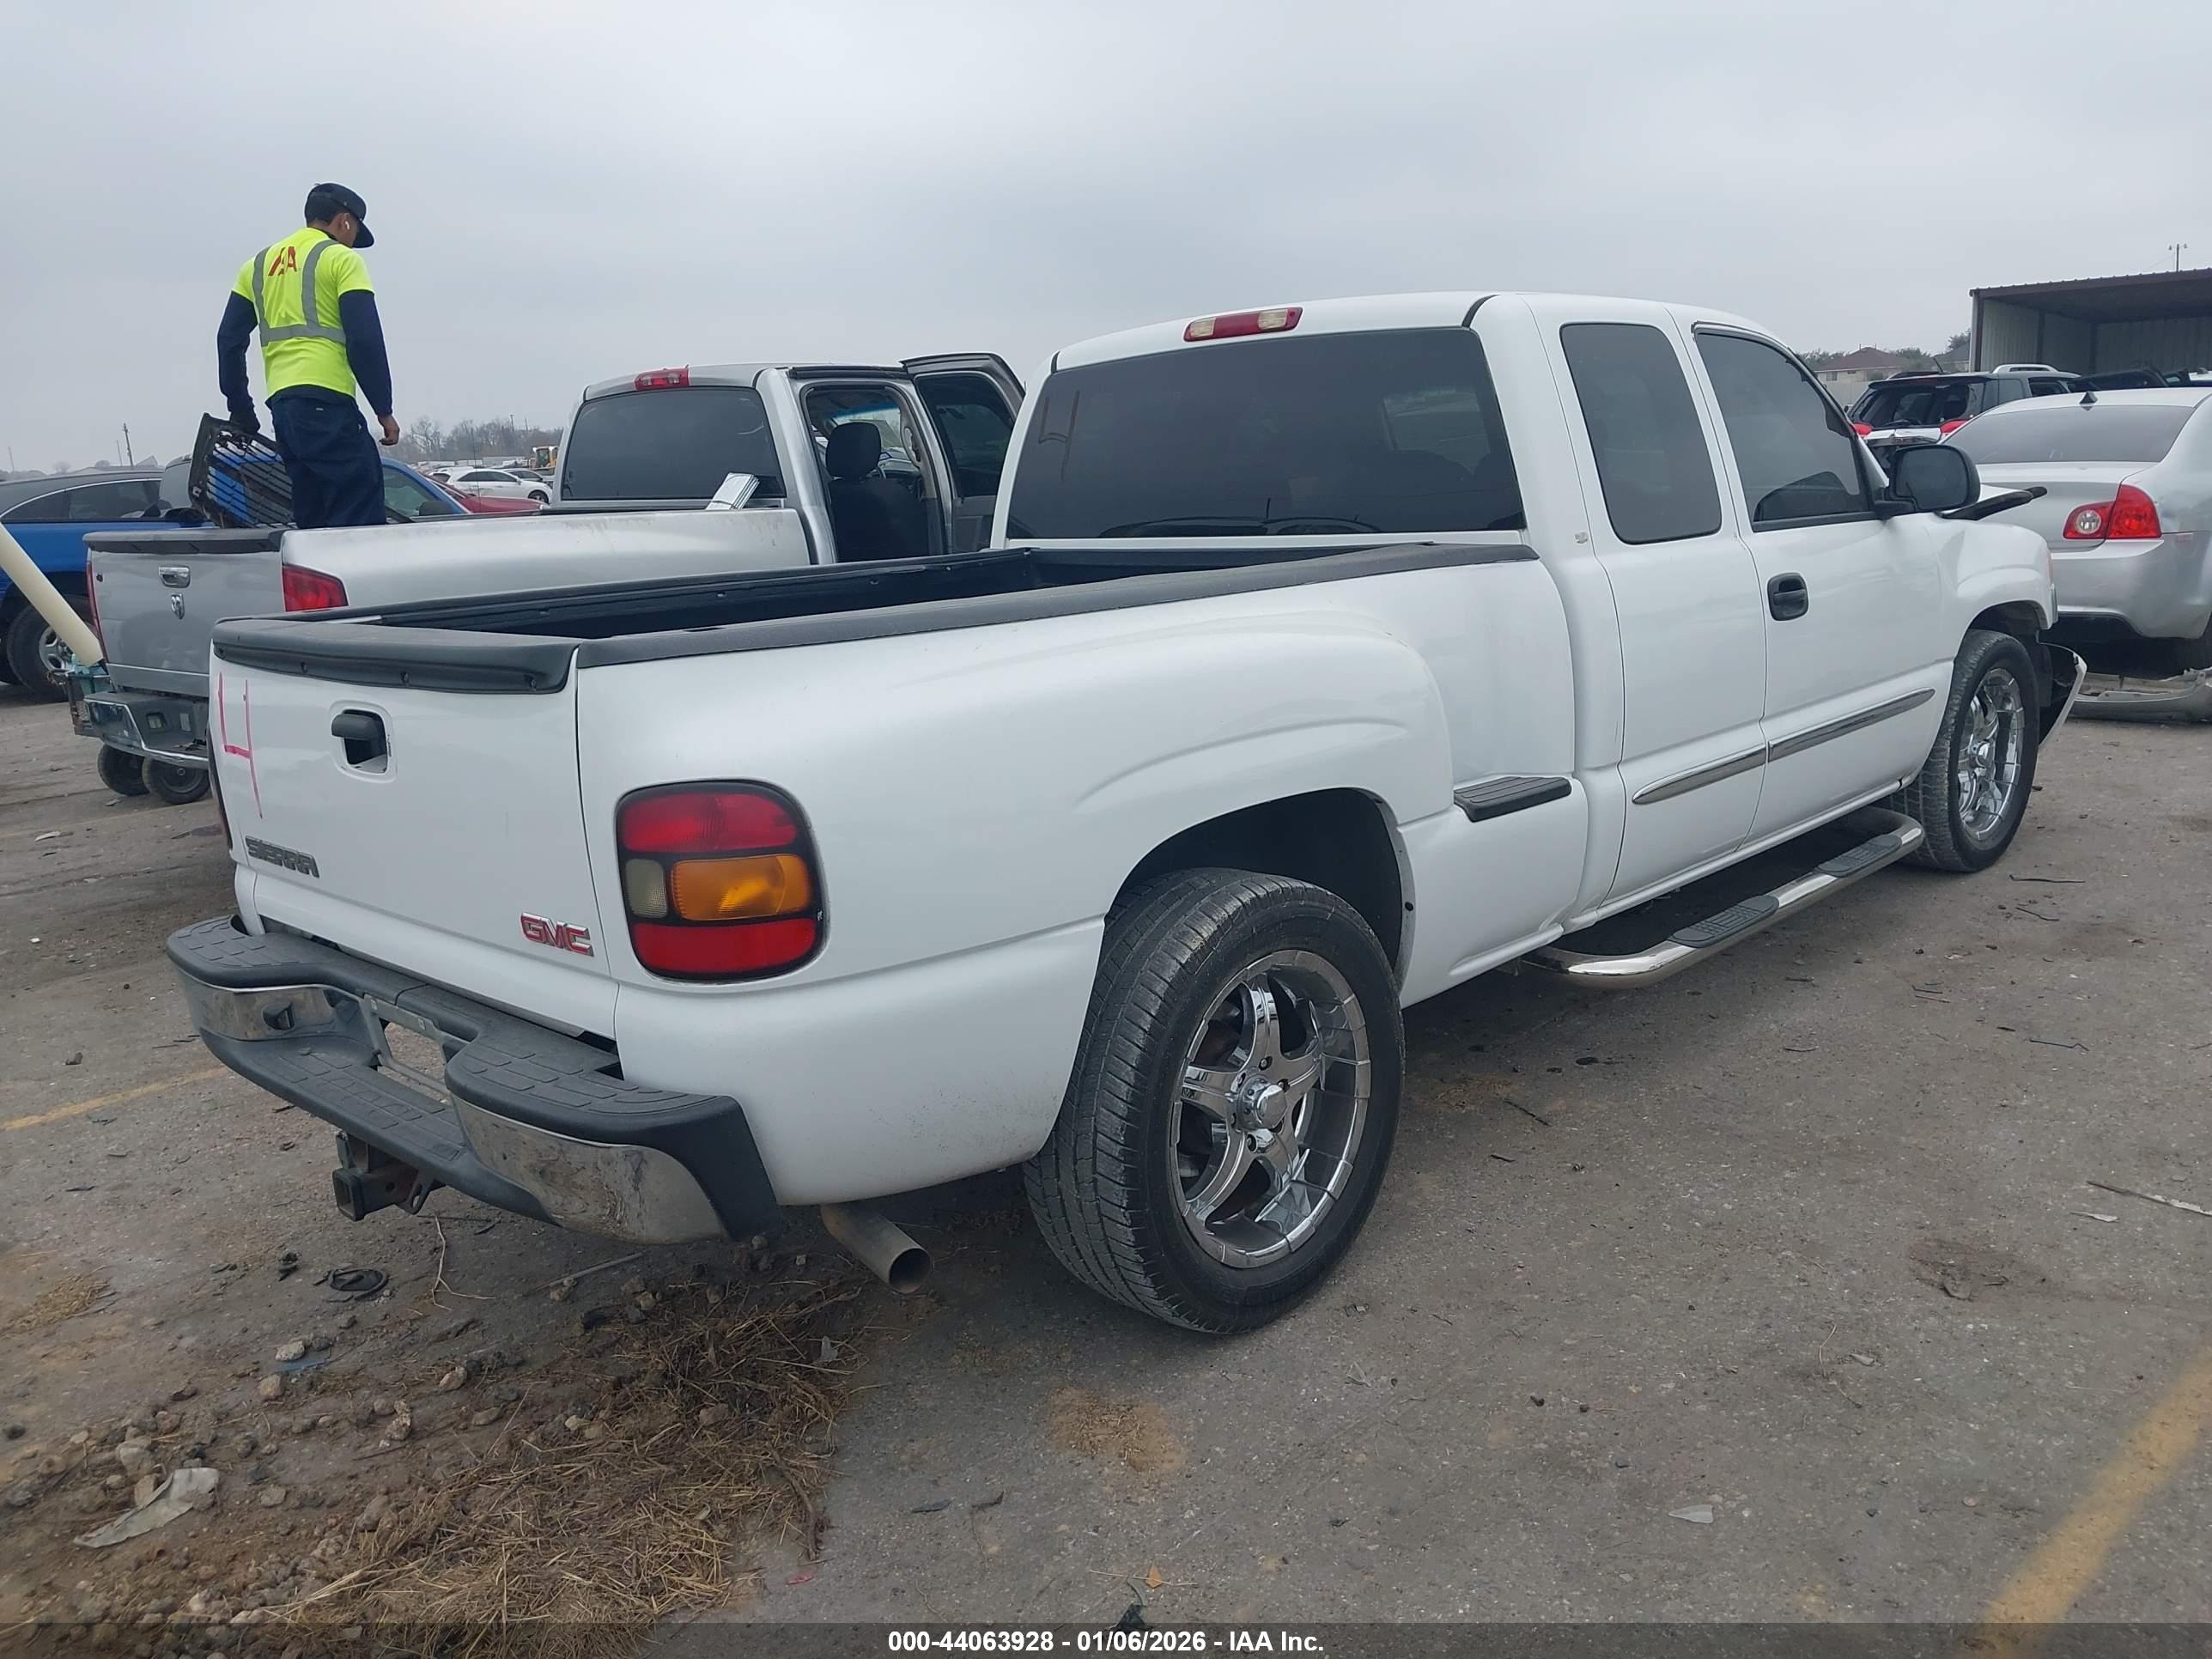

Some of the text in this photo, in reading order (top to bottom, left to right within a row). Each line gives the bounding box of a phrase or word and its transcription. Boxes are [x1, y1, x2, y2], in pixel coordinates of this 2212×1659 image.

[217, 671, 264, 819] 4
[245, 835, 320, 878] SIERRA
[520, 911, 595, 957] GMC
